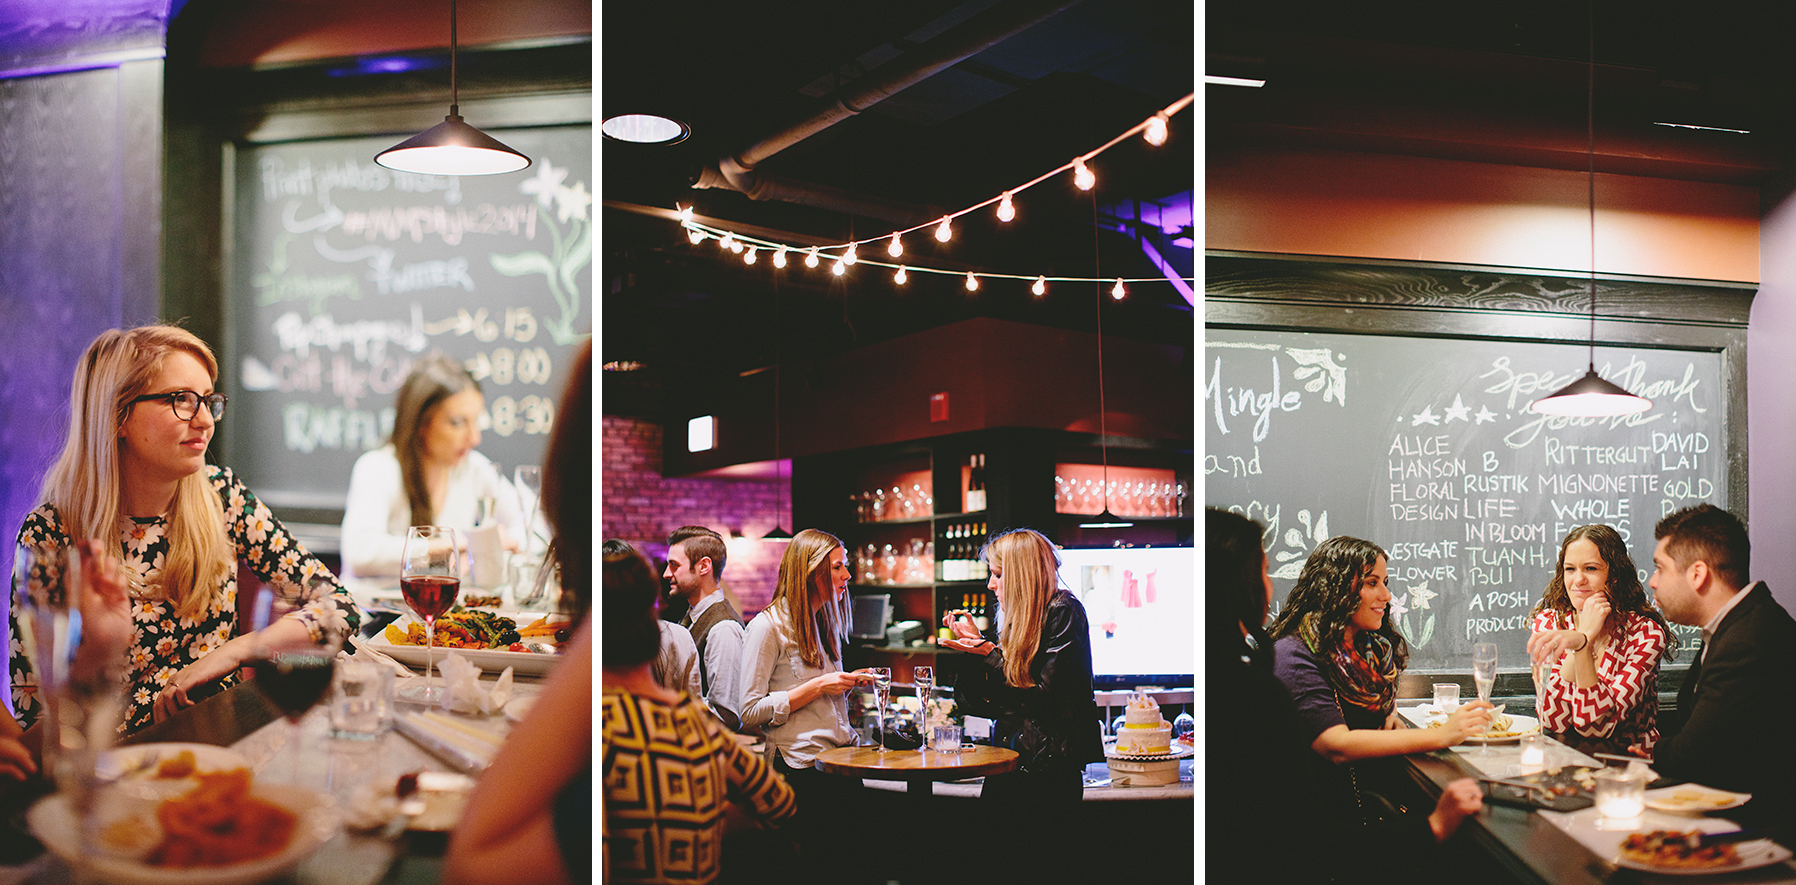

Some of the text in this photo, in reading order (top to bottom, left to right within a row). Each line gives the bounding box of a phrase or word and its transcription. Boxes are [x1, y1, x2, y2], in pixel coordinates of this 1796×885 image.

[1388, 433, 1451, 457] ALICE
[1544, 435, 1650, 467] RITTERGUT
[1651, 431, 1709, 455] DAVID
[1205, 445, 1263, 478] and
[1388, 458, 1466, 481] HANSON
[1482, 450, 1499, 472] B
[1661, 453, 1698, 471] LAI
[1390, 480, 1460, 502] FLORAL
[1464, 473, 1529, 494] RUSTIK
[1538, 474, 1659, 495] MIGNONETTE
[1663, 478, 1714, 500] GOLD
[1389, 503, 1458, 521] DESIGN
[1463, 497, 1520, 519] LIFE
[1550, 499, 1630, 521] WHOLE
[1469, 566, 1513, 586] BUI
[1486, 589, 1529, 610] POSH
